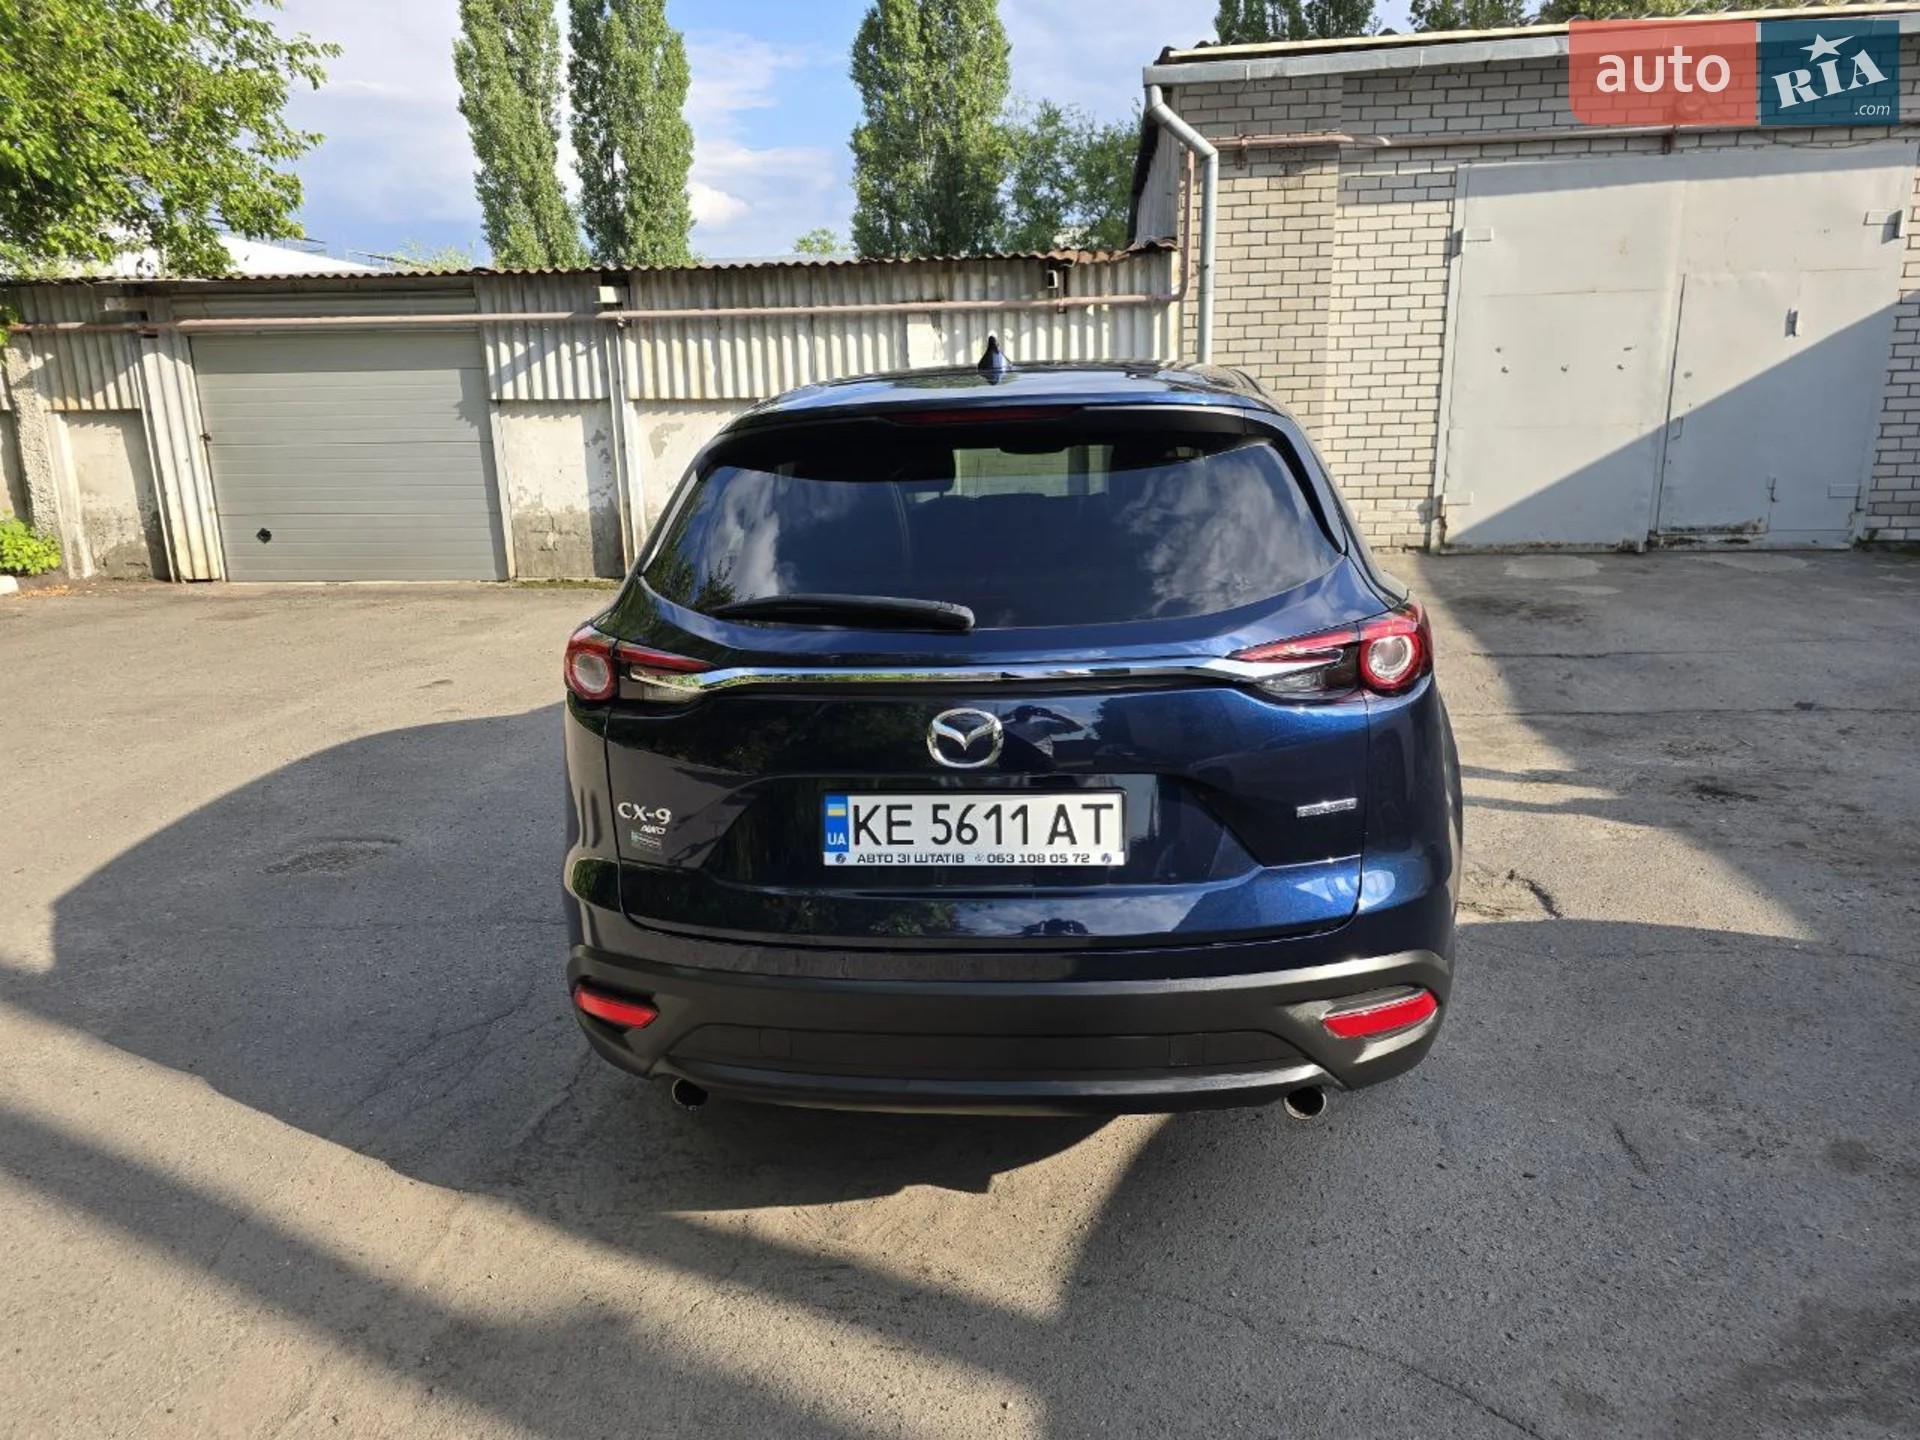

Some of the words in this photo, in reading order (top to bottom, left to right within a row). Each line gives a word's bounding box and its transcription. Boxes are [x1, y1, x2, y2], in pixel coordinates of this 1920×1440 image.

[617, 802, 672, 825] CX-9
[852, 804, 915, 846] KE
[931, 803, 1029, 846] 5611
[1046, 803, 1114, 846] AT
[827, 832, 847, 846] UA
[857, 853, 894, 864] АВТО
[914, 853, 965, 864] ШТАТІВ
[986, 853, 1015, 864] 063
[1018, 853, 1046, 864] 108
[1049, 853, 1068, 864] 05
[1072, 853, 1090, 864] 72
